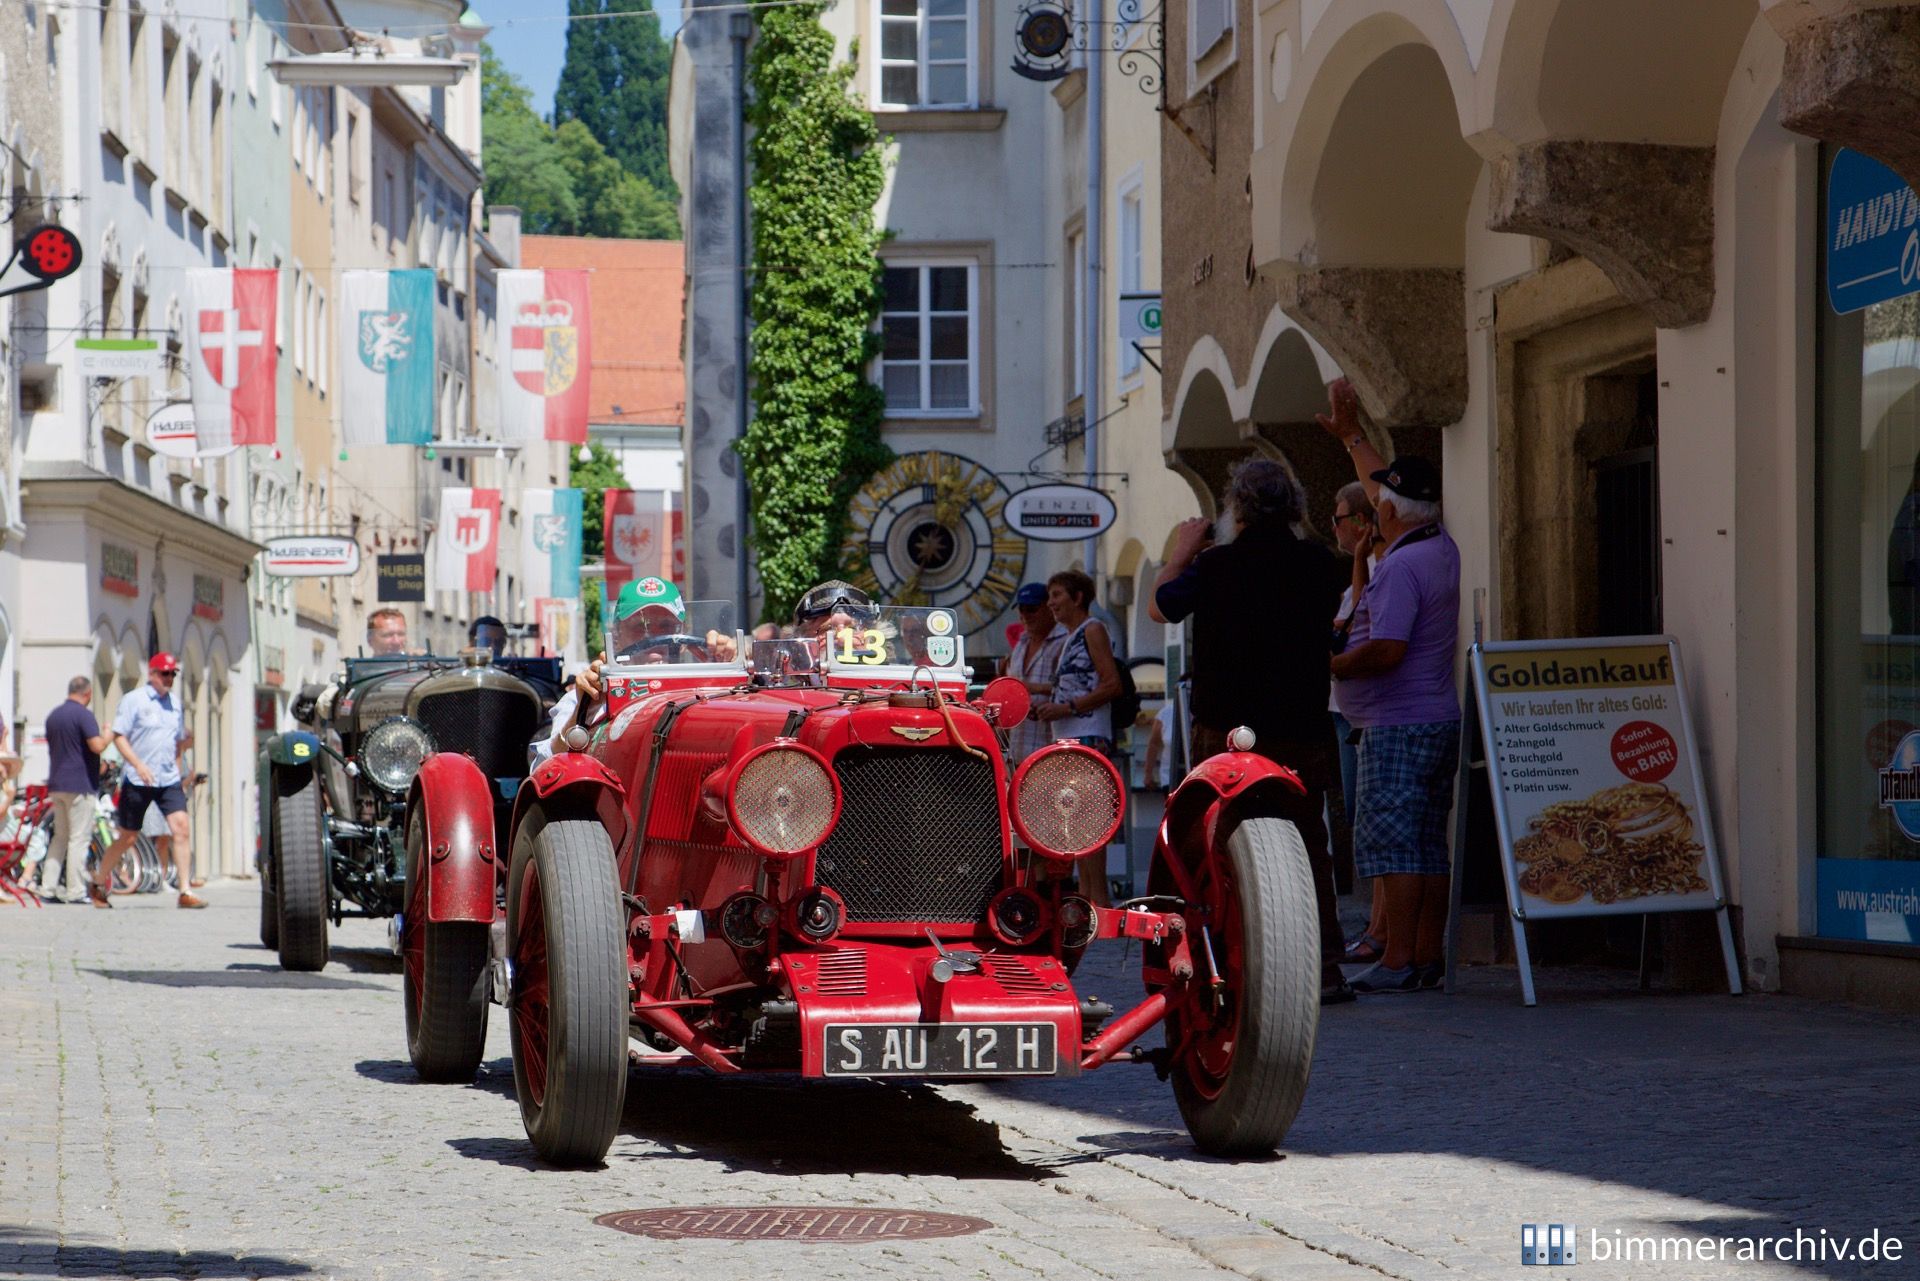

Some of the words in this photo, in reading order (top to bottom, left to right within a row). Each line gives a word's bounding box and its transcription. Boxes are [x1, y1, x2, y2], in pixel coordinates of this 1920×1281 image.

[1835, 186, 1920, 251] HANDYB
[1901, 228, 1920, 286] O
[377, 564, 423, 577] HUBER
[836, 627, 887, 666] 13
[1487, 655, 1669, 688] Goldankauf
[1501, 702, 1526, 717] Wir
[1529, 699, 1574, 716] kaufen
[1576, 698, 1594, 714] Ihr
[1598, 697, 1630, 713] altes
[1631, 694, 1668, 712] Gold:
[1504, 724, 1530, 734] Alter
[1532, 720, 1605, 733] Goldschmuck
[1620, 726, 1653, 744] Sofort
[293, 742, 310, 757] 8
[1506, 737, 1556, 750] Zahngold
[1616, 737, 1671, 761] Bezahlung
[1508, 751, 1563, 765] Bruchgold
[1637, 749, 1674, 772] BAR!
[1511, 766, 1579, 779] Goldmünzen
[1513, 782, 1545, 794] Platin
[1547, 783, 1572, 793] usw.
[1836, 887, 1920, 916] www.austriah
[840, 1029, 863, 1070] S
[882, 1028, 928, 1070] AU
[955, 1028, 998, 1069] 12
[1016, 1027, 1040, 1069] H
